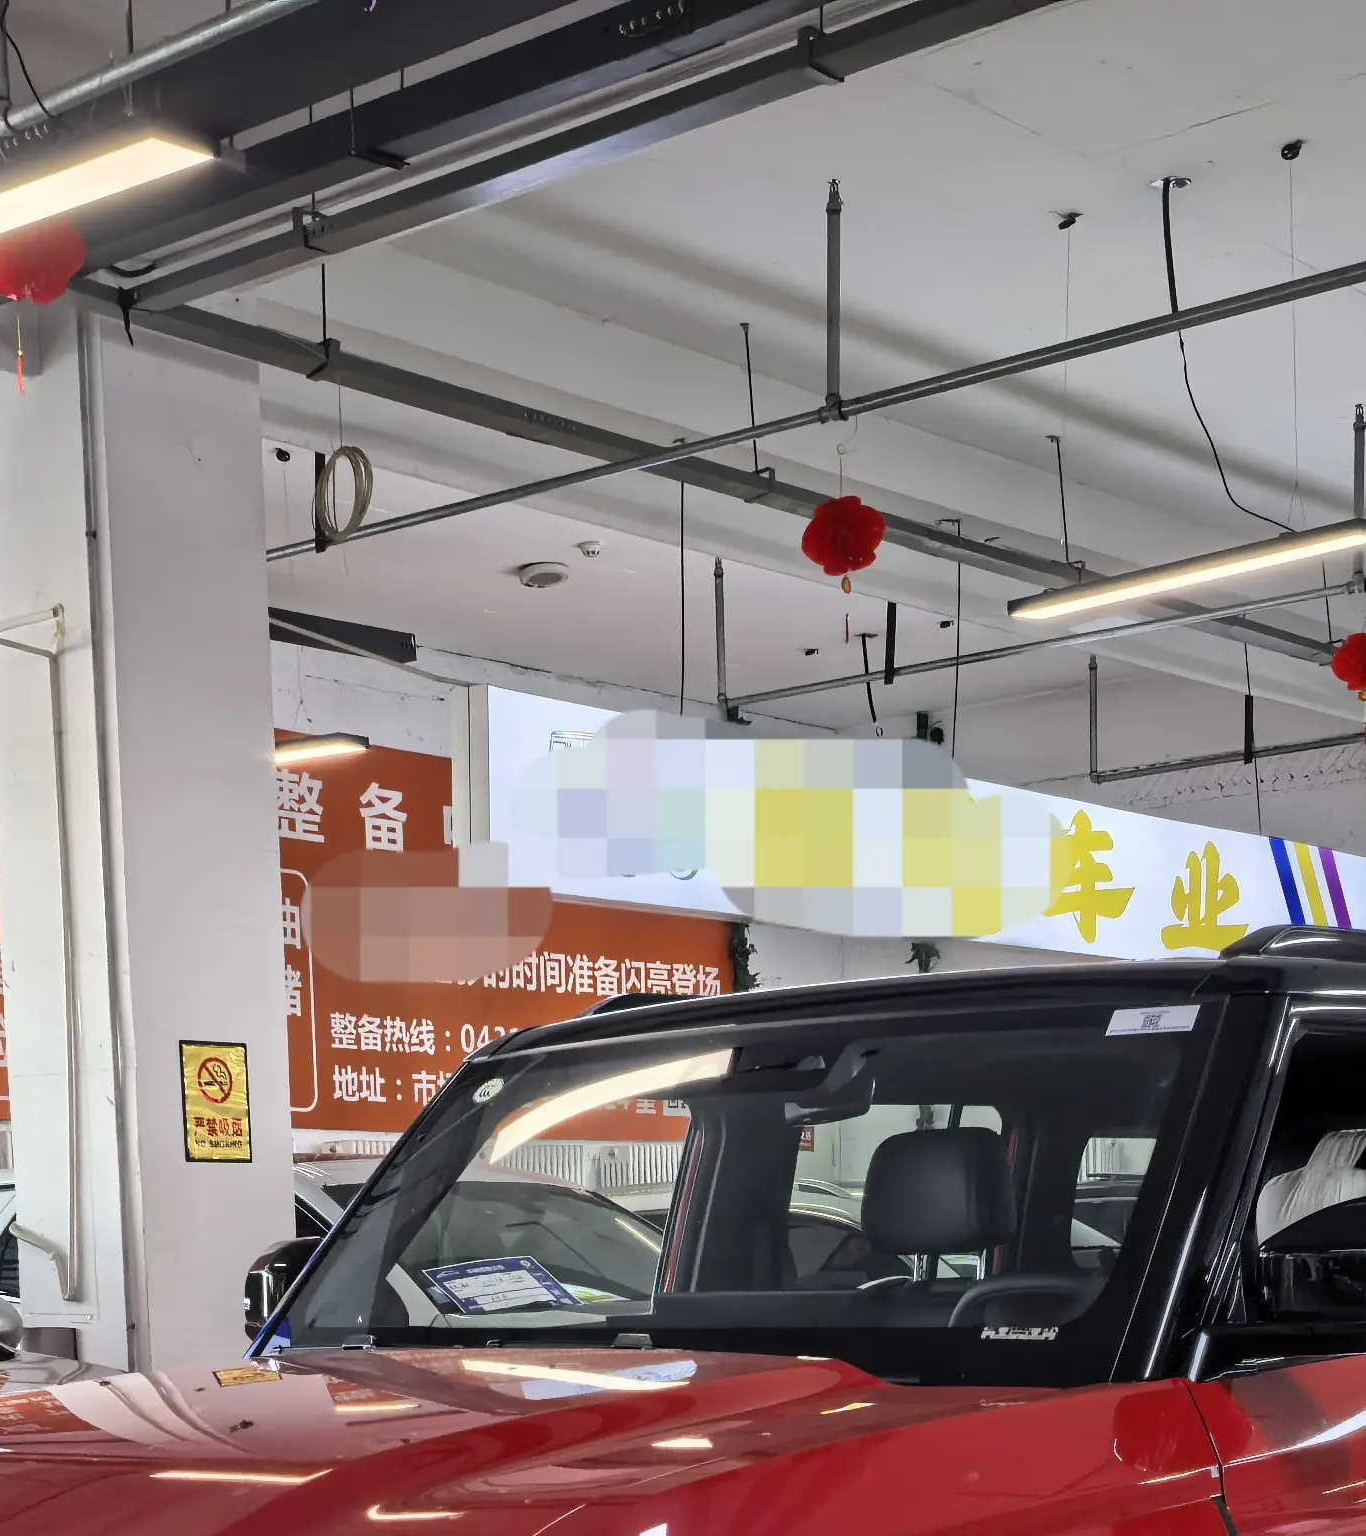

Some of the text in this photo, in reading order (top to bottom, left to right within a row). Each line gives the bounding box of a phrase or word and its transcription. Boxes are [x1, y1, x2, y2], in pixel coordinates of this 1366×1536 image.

[1041, 809, 1249, 952] 车业
[434, 951, 722, 998] 的时间准备闪亮登场
[194, 1117, 243, 1137] 严禁吸烟
